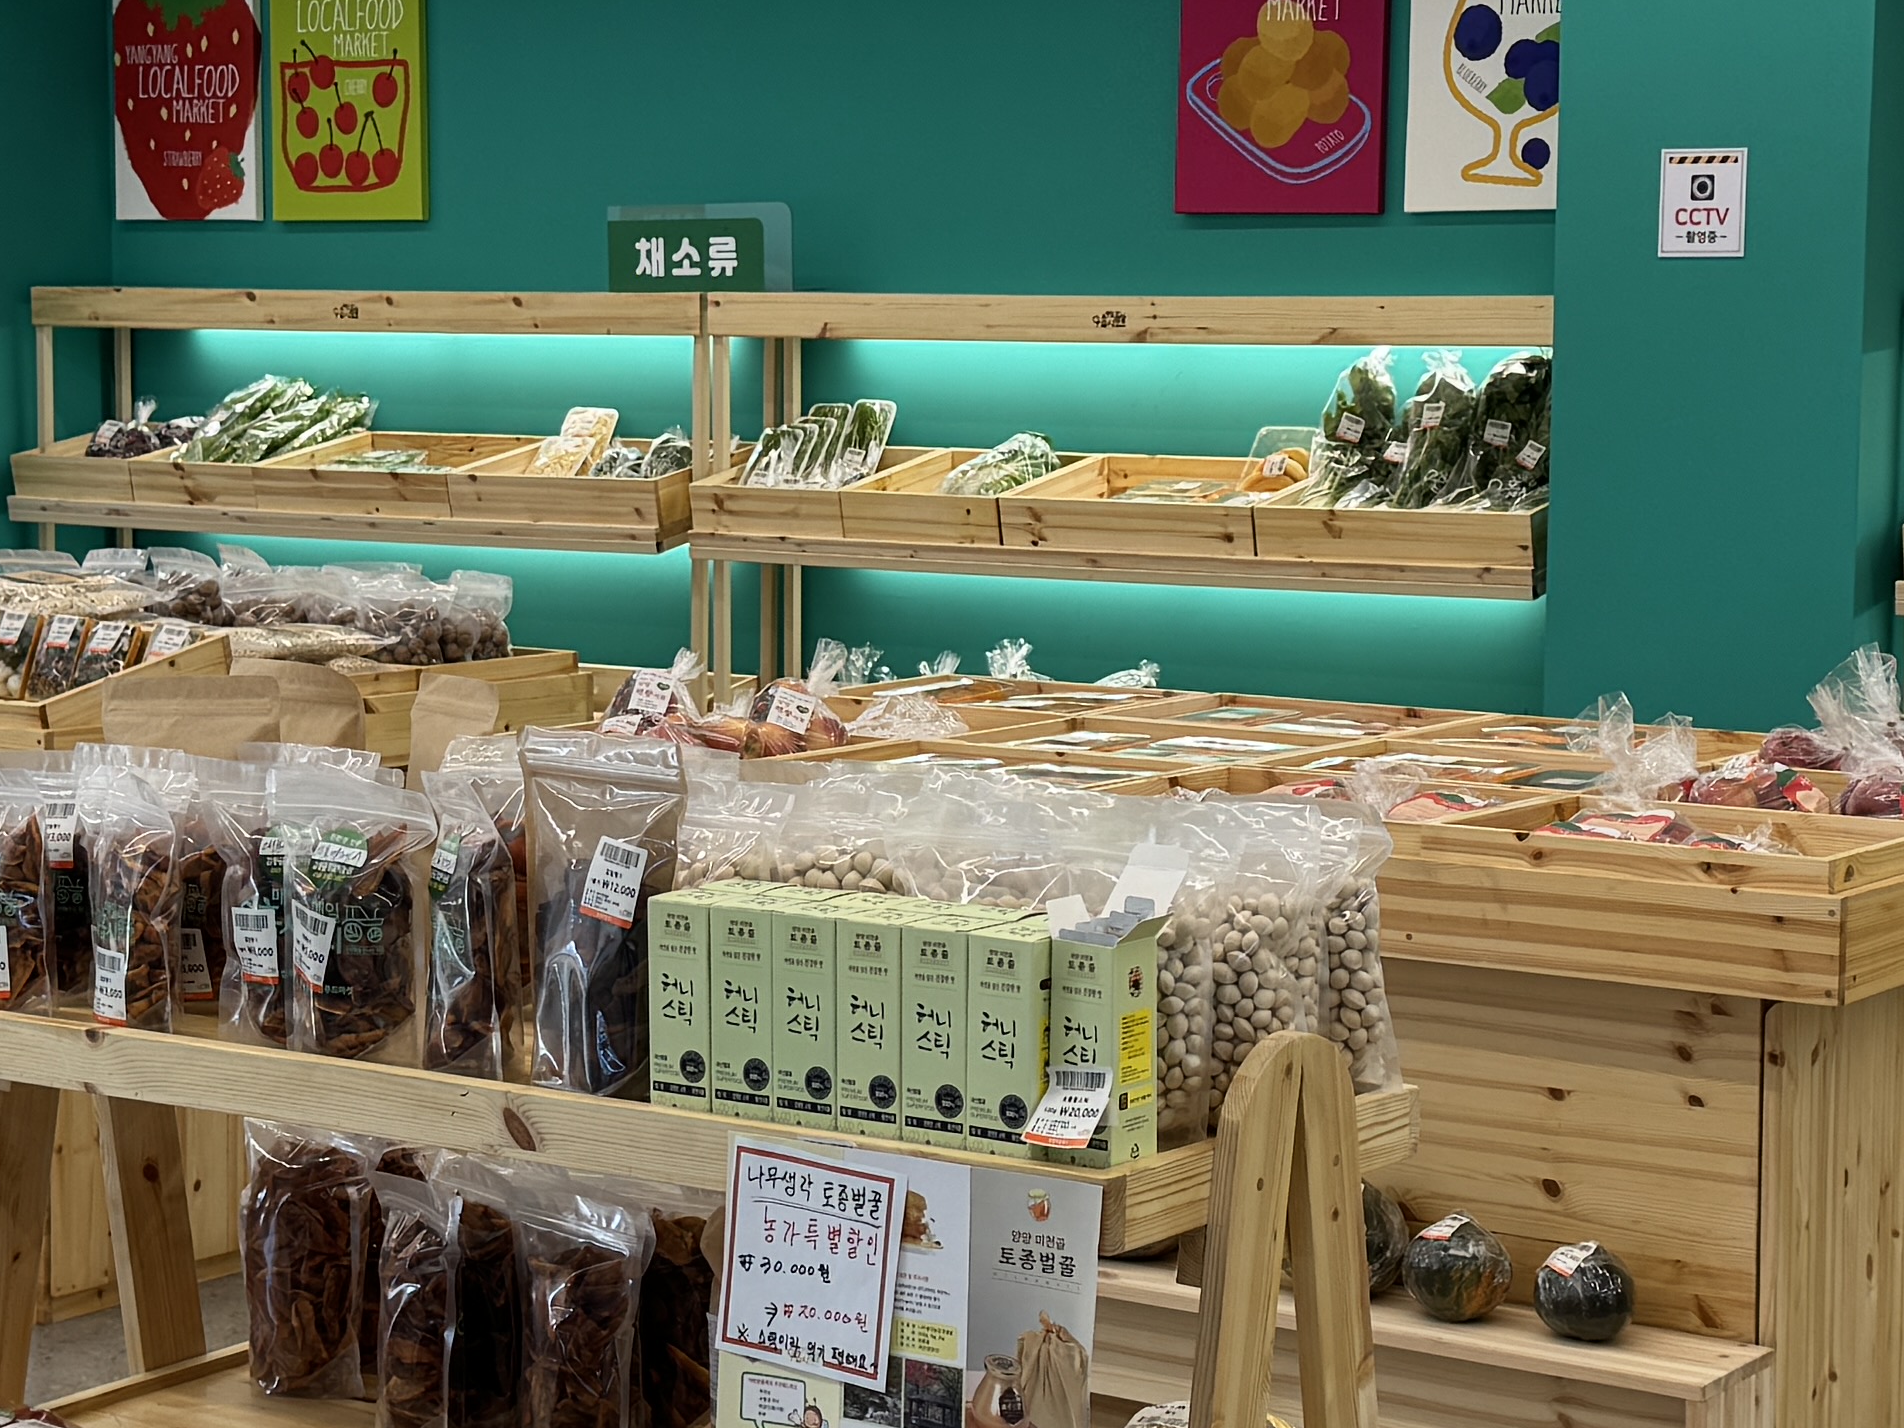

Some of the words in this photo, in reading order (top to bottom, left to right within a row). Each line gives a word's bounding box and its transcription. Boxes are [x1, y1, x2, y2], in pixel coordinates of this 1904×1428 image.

[125, 44, 179, 66] YANGYANG
[333, 31, 390, 58] MARKET
[138, 64, 239, 100] LOCALFOOD
[172, 98, 226, 125] MARKET
[1315, 129, 1345, 154] POTATO
[1675, 207, 1730, 227] CCTV
[635, 235, 738, 278] 채소류
[661, 973, 694, 997] 허니
[724, 979, 758, 1005] 허니
[661, 999, 693, 1026] 스틱
[786, 987, 820, 1012] 허니
[850, 994, 884, 1020] 허니
[725, 1006, 757, 1034] 스틱
[787, 1014, 819, 1042] 스틱
[916, 1002, 951, 1028] 허니
[981, 1011, 1016, 1038] 허니
[851, 1022, 883, 1050] 스틱
[1063, 1016, 1098, 1043] 허니
[916, 1031, 950, 1060] 스틱
[981, 1039, 1015, 1070] 스틱
[1059, 1105, 1100, 1119] ₩20,000
[747, 1164, 814, 1202] 나무생각
[822, 1181, 883, 1221] 토종벌꿀
[999, 1245, 1077, 1278] 토종벌꿀
